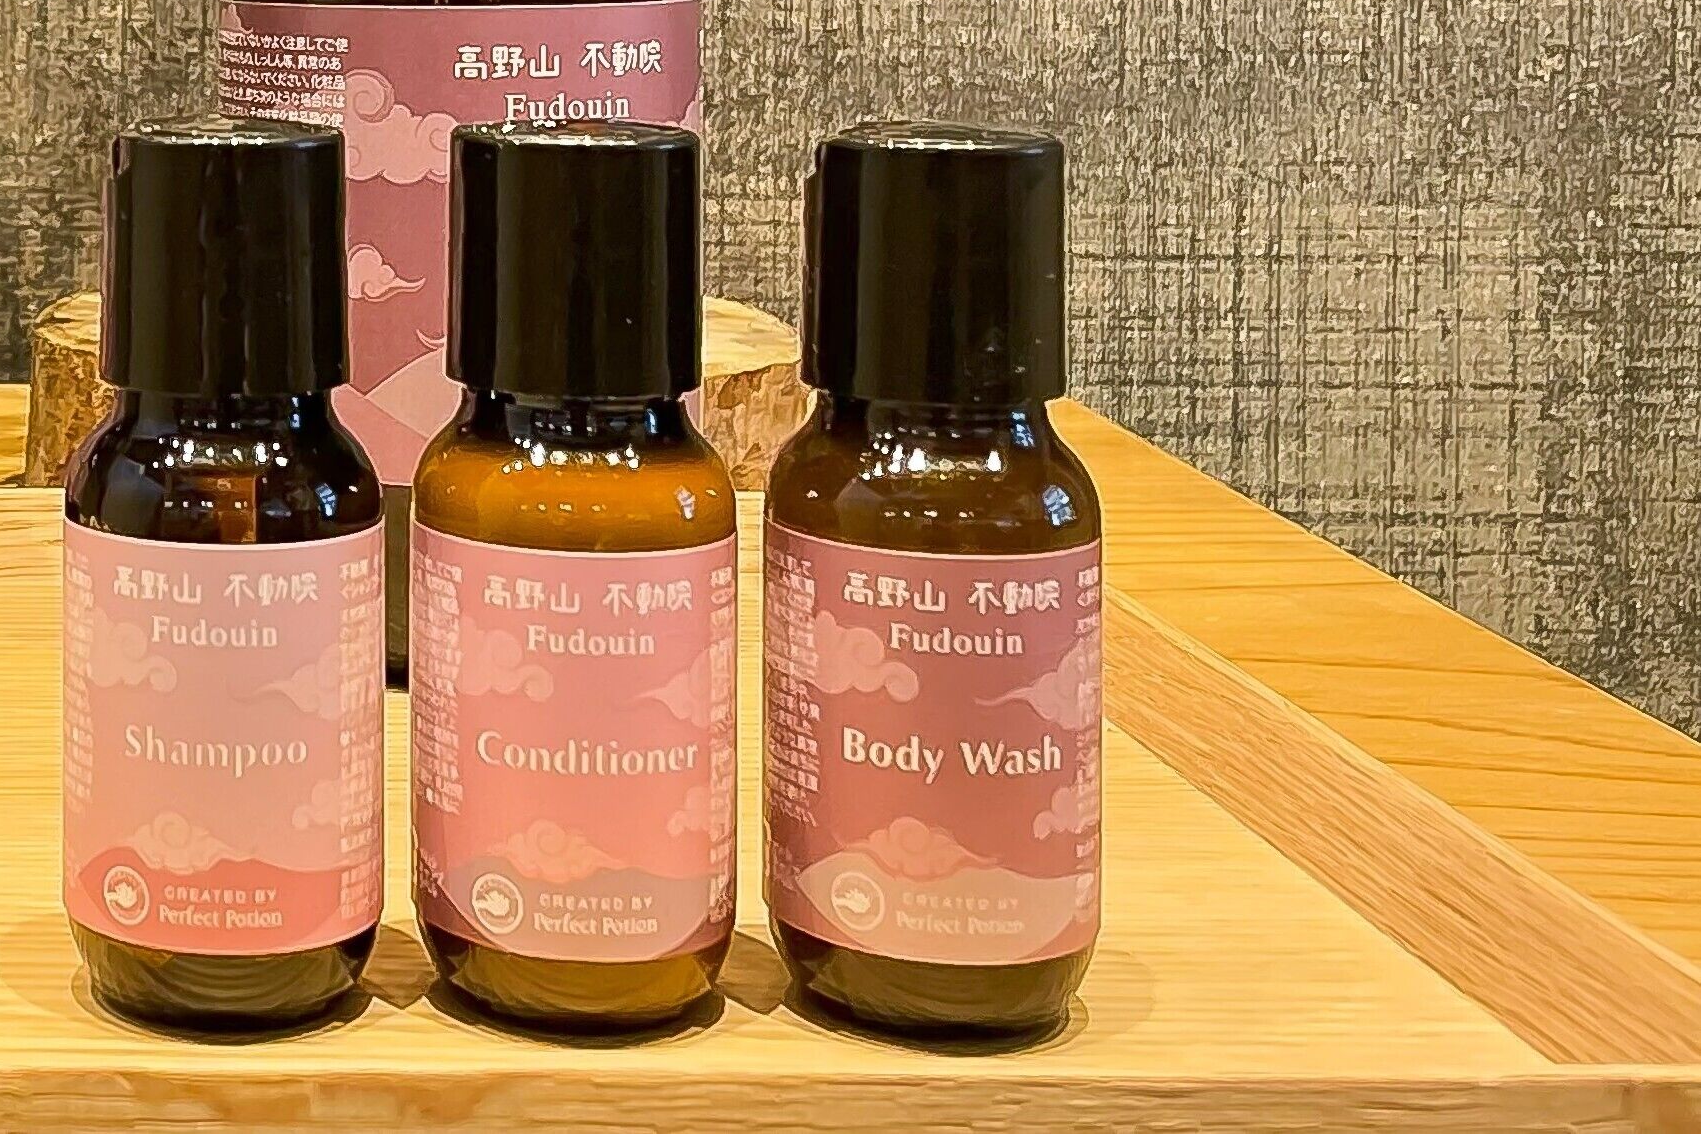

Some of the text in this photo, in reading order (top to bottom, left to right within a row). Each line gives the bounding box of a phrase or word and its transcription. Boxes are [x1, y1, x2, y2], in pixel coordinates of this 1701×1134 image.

[453, 41, 663, 80] 高野山 不動院
[504, 92, 631, 122] Fudouin
[113, 565, 319, 607] 高野山 不動院
[483, 575, 694, 615] 高野山 不動院
[842, 571, 1062, 615] 高野山 不動院
[151, 616, 279, 648] Fudouin
[526, 624, 656, 657] Fudouin
[888, 623, 1025, 657] Fudouin
[124, 724, 308, 779] Shampoo
[476, 729, 699, 777] Conditioner
[842, 727, 1063, 784] Body Wash
[164, 884, 277, 904] CREATED BY
[539, 893, 624, 912] CREATED
[158, 904, 284, 930] Perfect Potion
[532, 911, 598, 935] Perfect
